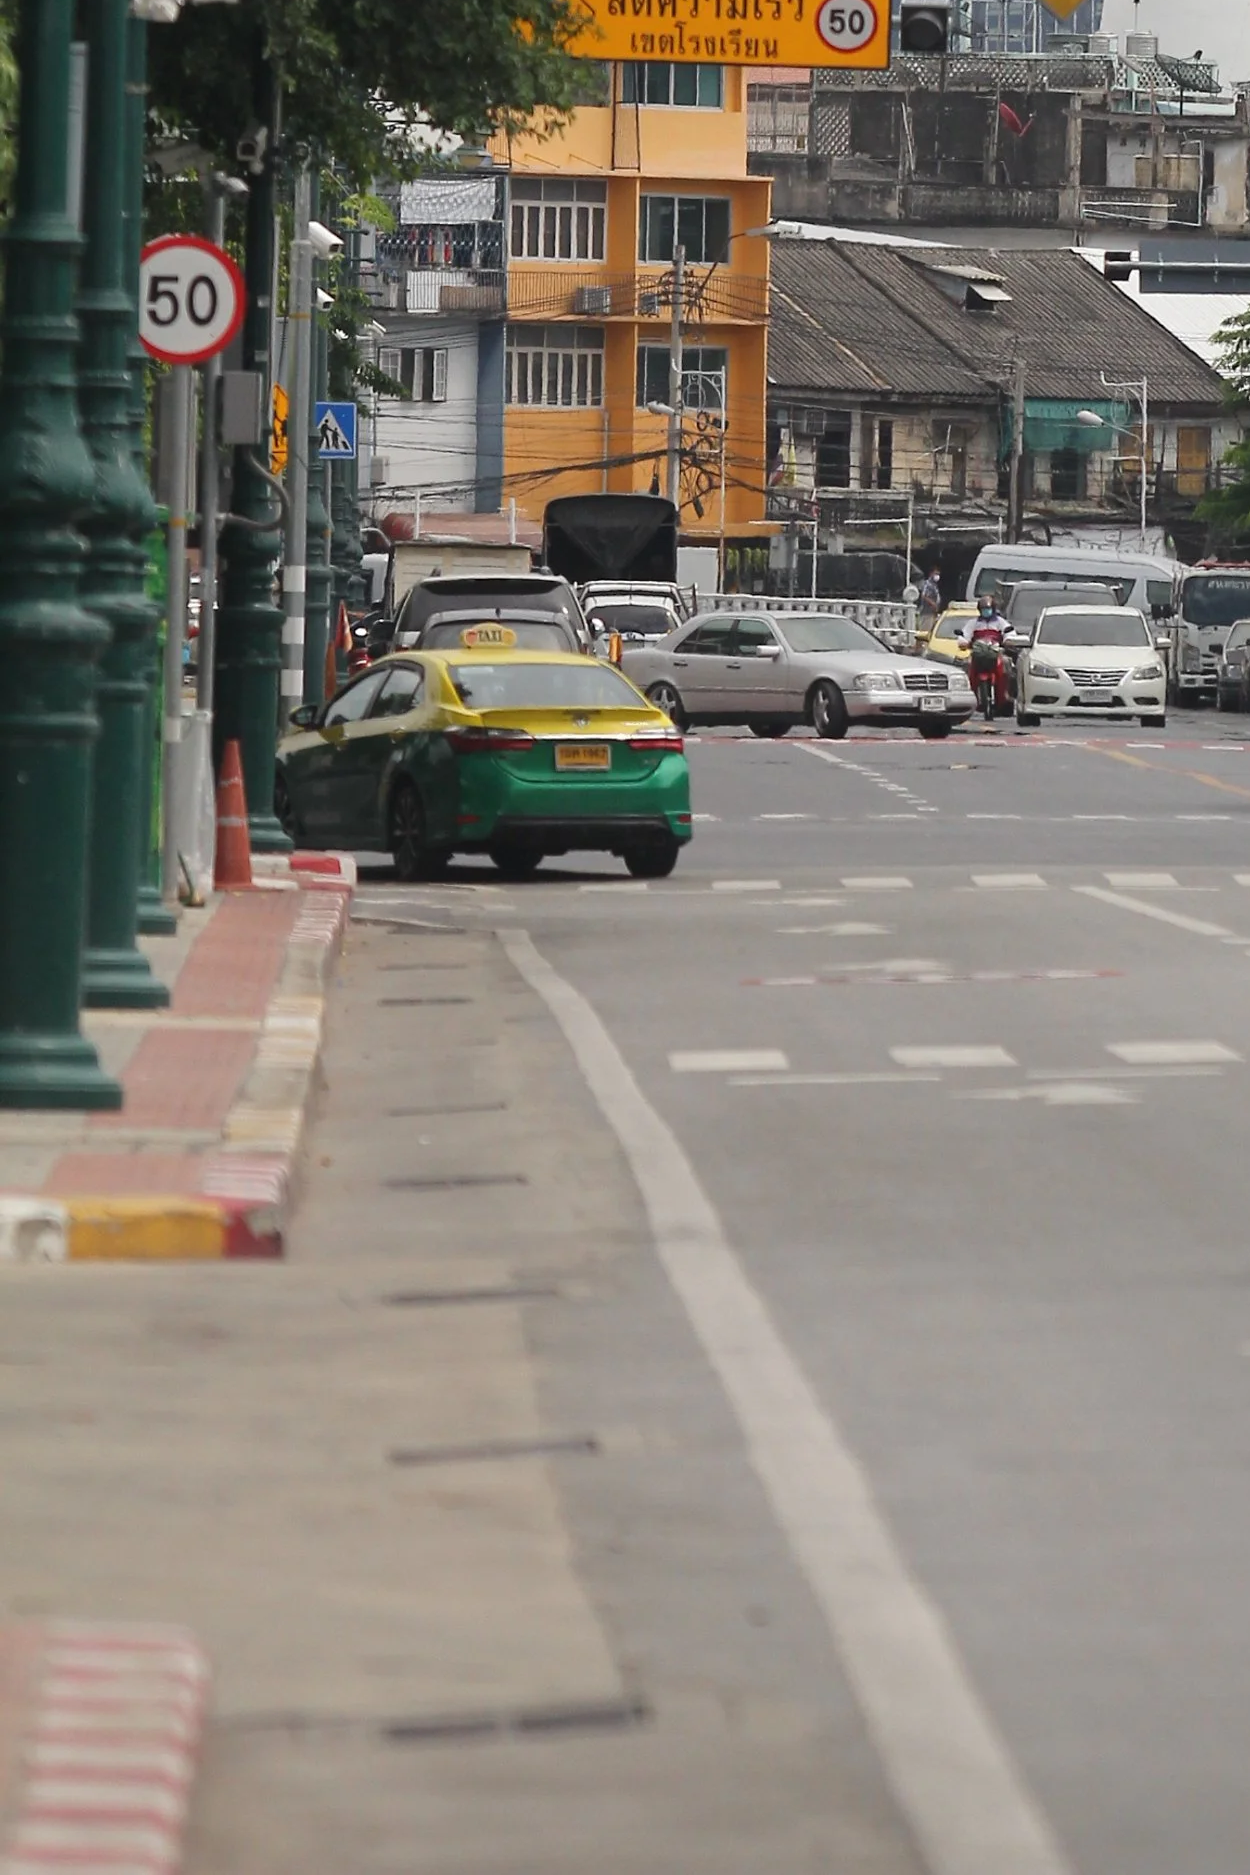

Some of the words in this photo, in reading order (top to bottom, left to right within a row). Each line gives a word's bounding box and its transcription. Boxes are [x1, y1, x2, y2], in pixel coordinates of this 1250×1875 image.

[827, 8, 866, 36] 50
[629, 21, 779, 59] เขตโรงเรียน
[146, 274, 218, 327] 50
[477, 629, 503, 643] TAXI
